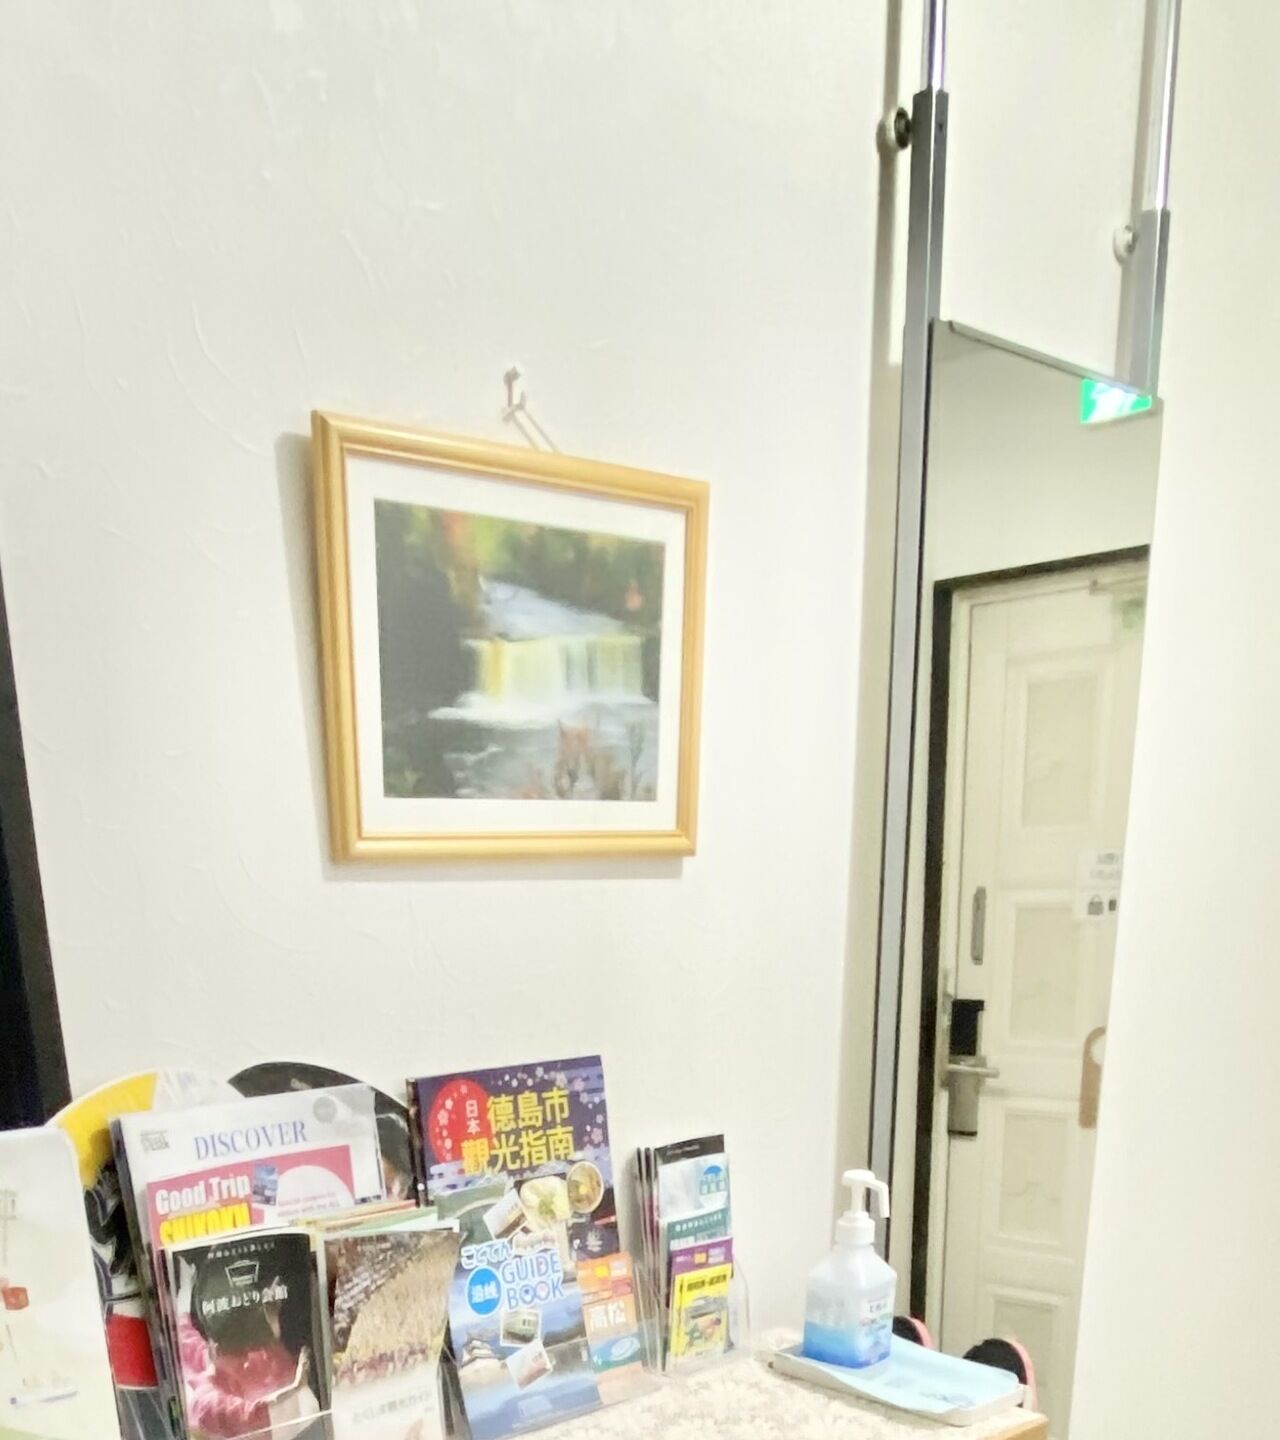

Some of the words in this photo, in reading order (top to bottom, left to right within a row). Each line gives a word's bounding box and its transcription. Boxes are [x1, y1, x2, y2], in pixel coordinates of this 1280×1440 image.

[465, 1099, 481, 1135] 日本
[193, 1119, 309, 1162] DISCOVER
[154, 1180, 207, 1216] Good
[208, 1173, 252, 1205] Trip
[159, 1202, 252, 1248] SHIKOKU
[500, 1251, 563, 1285] GUIDE
[506, 1277, 565, 1311] BOOK
